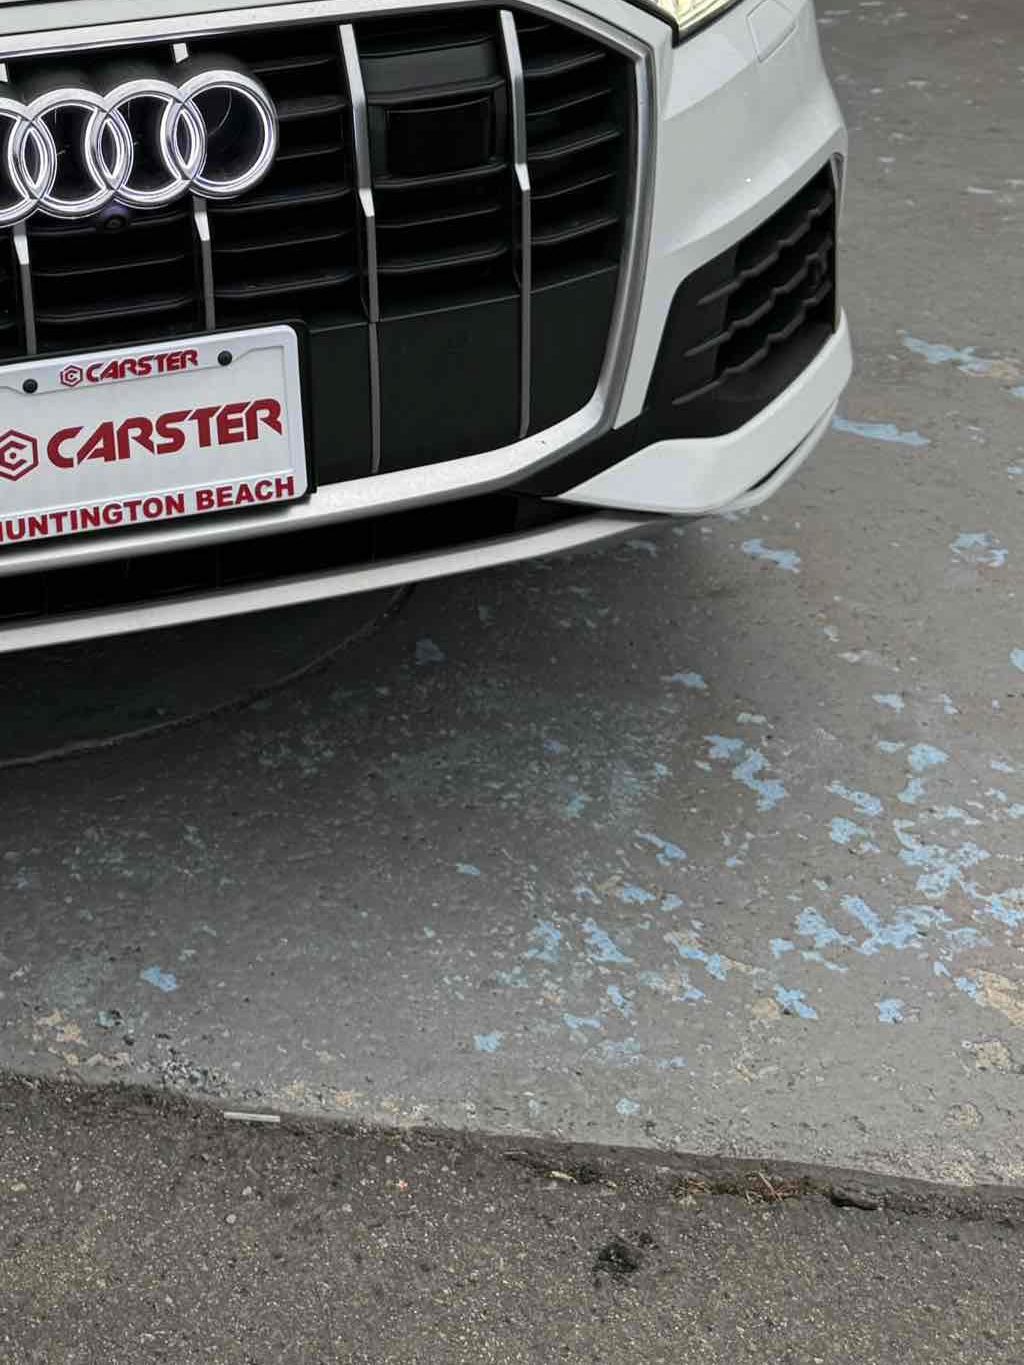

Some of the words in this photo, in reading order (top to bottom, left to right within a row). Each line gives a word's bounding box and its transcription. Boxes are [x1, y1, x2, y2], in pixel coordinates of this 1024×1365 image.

[85, 349, 199, 383] CARSTER
[46, 397, 283, 469] CARSTER
[195, 475, 295, 511] BEACH
